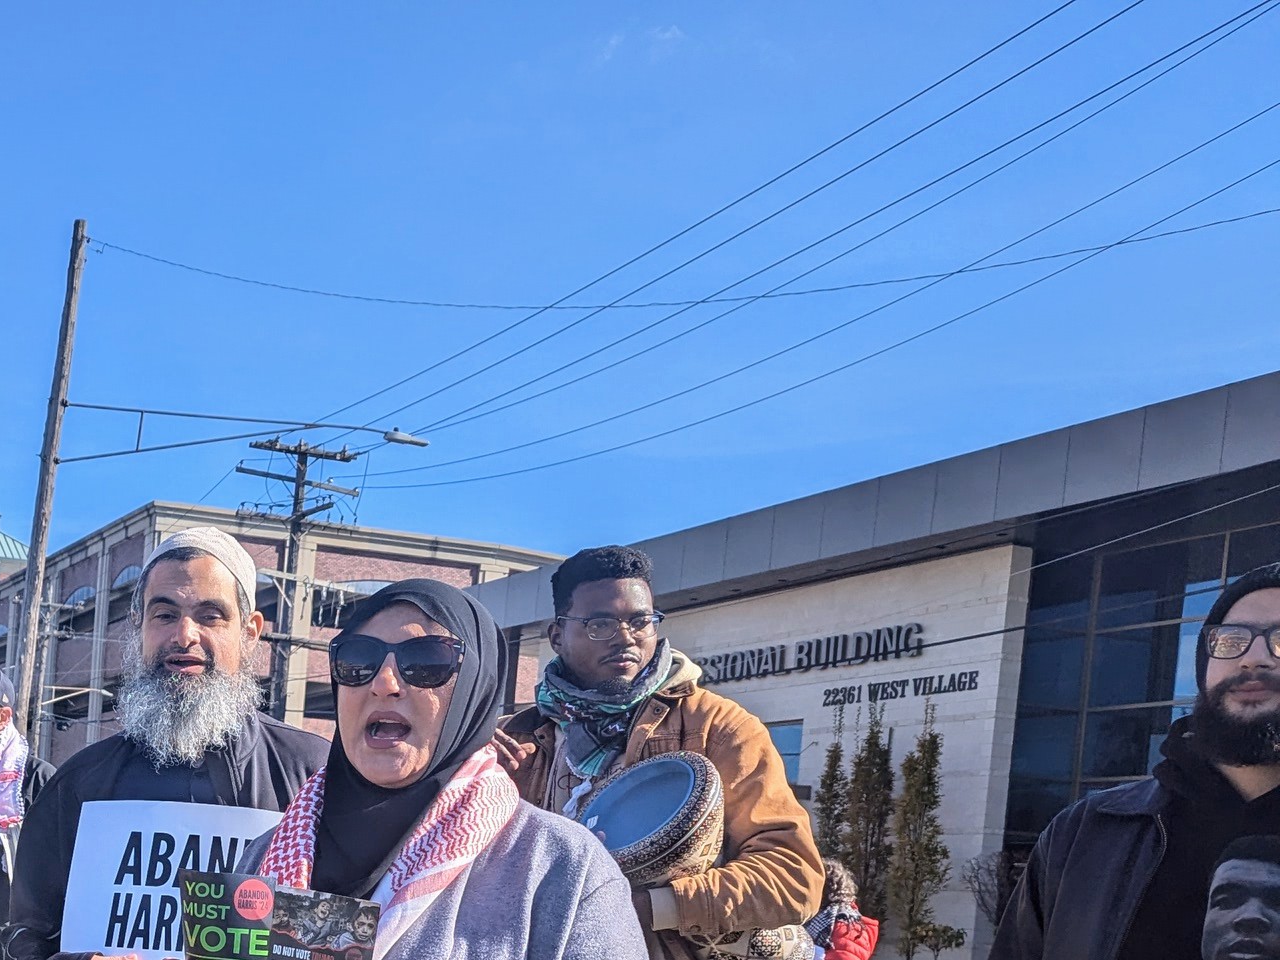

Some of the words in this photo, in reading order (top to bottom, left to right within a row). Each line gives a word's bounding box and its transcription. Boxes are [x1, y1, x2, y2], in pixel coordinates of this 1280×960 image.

[795, 622, 925, 673] BUILDING
[823, 685, 862, 707] 22361
[868, 678, 909, 702] WEST
[913, 671, 979, 696] VILLAGE
[114, 831, 253, 888] ABAN
[185, 881, 224, 899] YOU
[238, 889, 269, 900] ABANDON
[183, 899, 230, 920] MUST
[238, 899, 257, 910] HARRIS
[105, 892, 184, 952] HAR
[184, 920, 270, 956] VOTE
[273, 945, 281, 954] DO
[282, 946, 295, 957] NOT
[296, 948, 311, 960] VOTE
